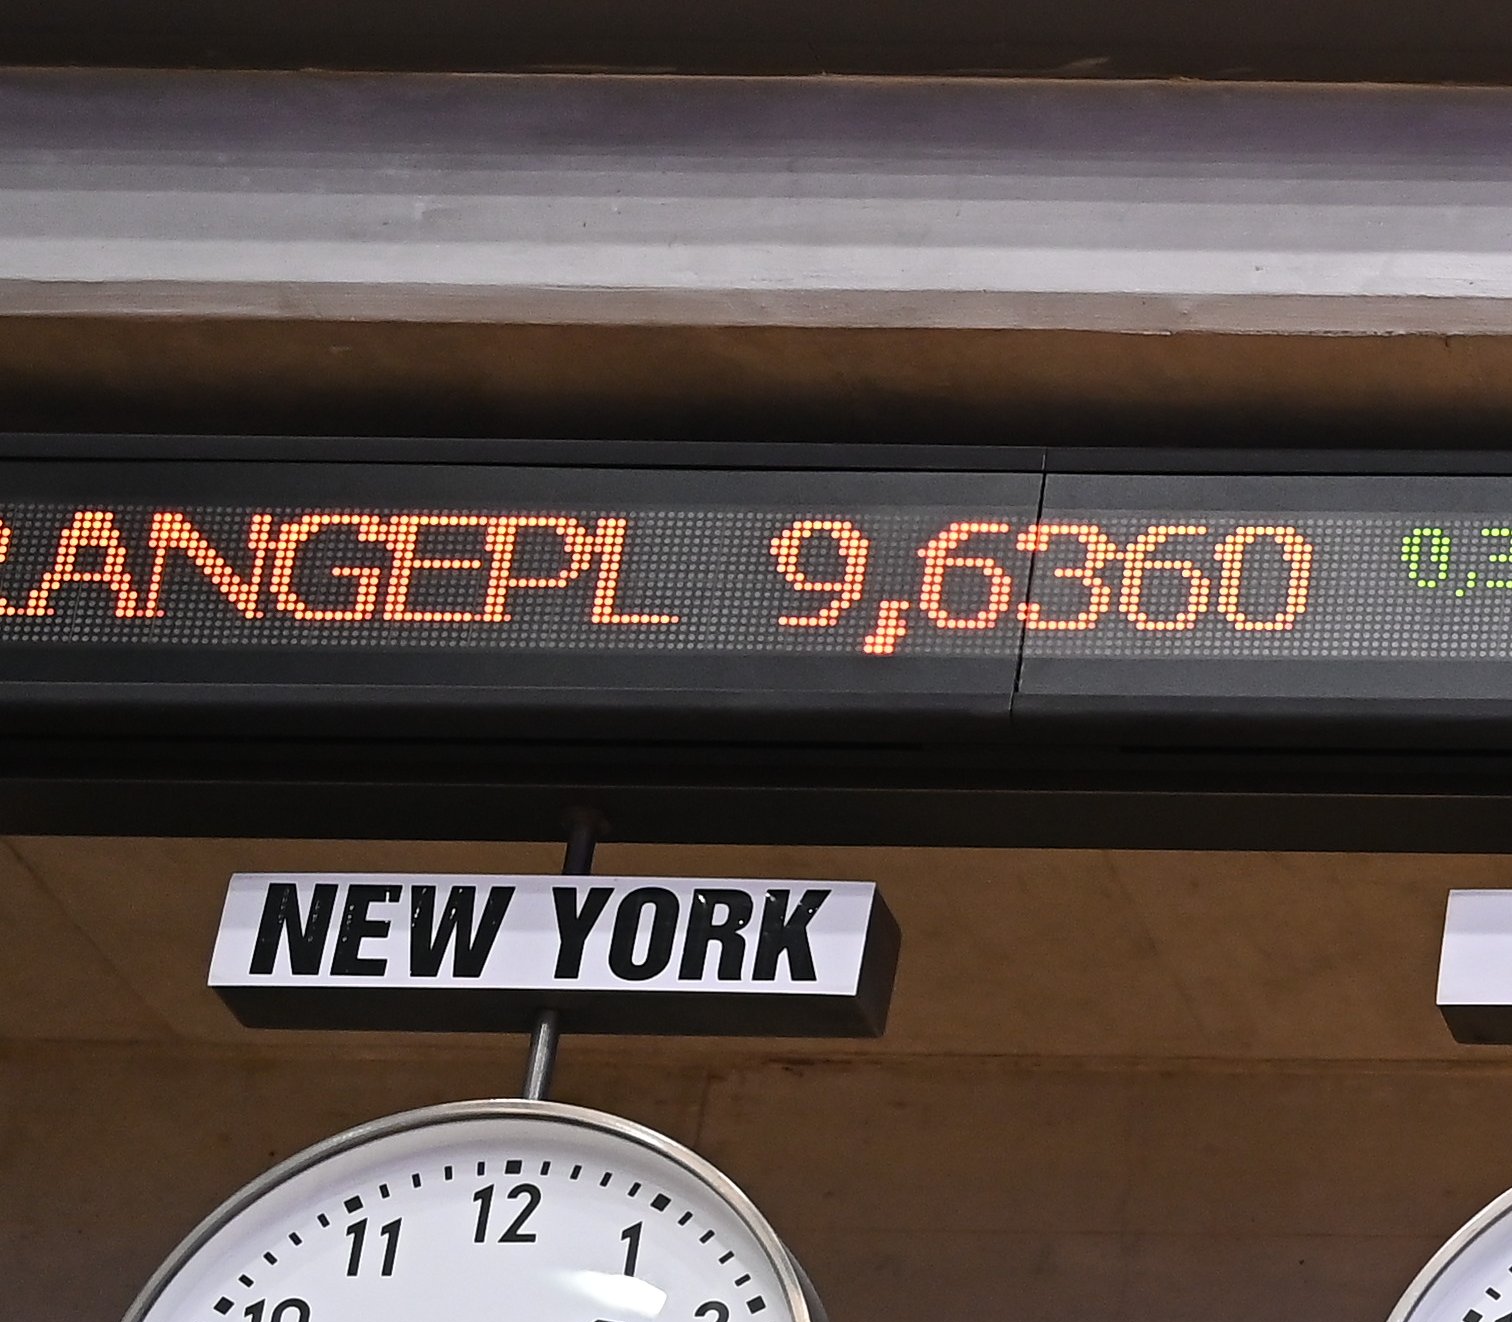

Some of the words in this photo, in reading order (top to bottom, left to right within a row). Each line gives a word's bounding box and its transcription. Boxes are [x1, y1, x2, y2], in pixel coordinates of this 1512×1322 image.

[0, 512, 678, 623] ANGEPL
[772, 521, 1312, 655] 9,6360
[250, 883, 515, 977] NEW
[553, 887, 830, 981] YORK
[472, 1183, 542, 1243] 12
[345, 1217, 403, 1277] 11
[620, 1221, 643, 1278] 1
